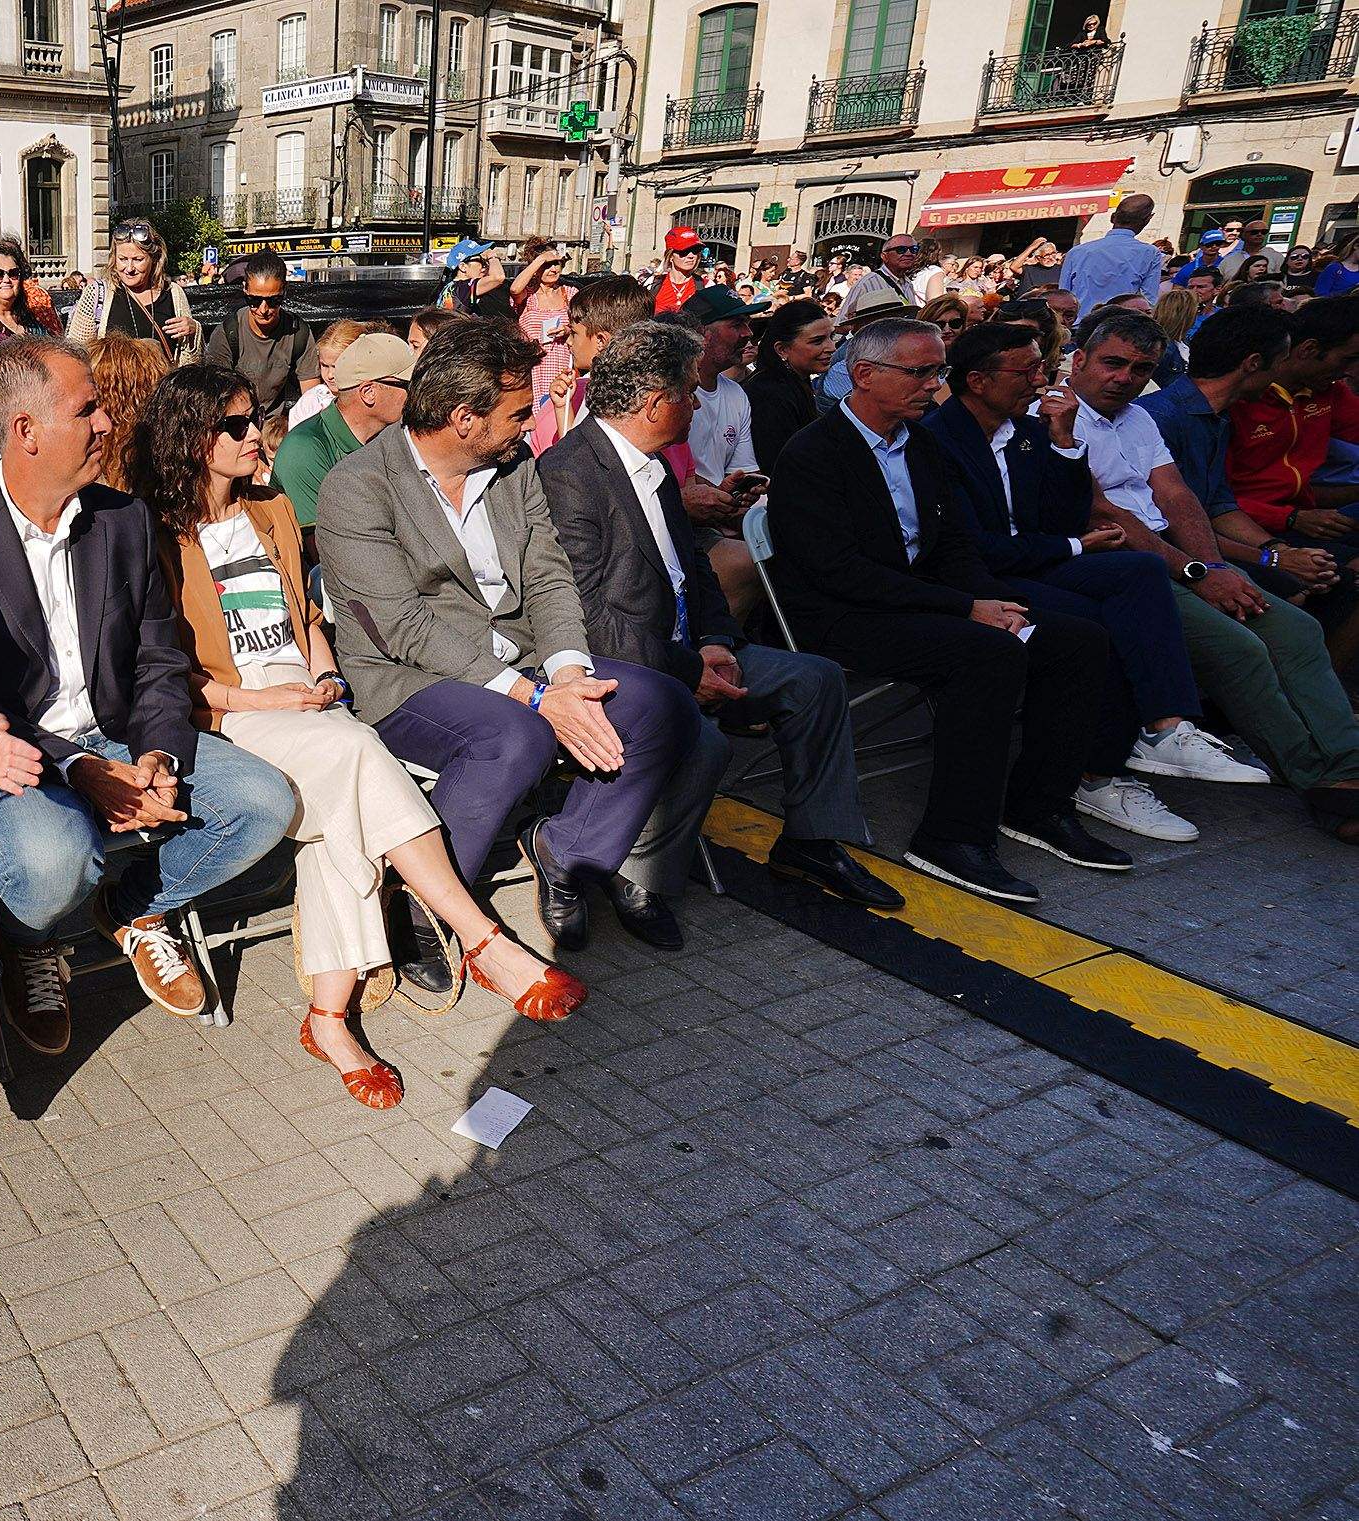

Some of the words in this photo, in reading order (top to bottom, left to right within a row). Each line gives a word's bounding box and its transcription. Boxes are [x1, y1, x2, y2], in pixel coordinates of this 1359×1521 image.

[308, 79, 350, 95] DENTAL
[392, 83, 422, 96] DENTAL
[1255, 175, 1288, 183] ESPAÑA
[947, 203, 1065, 225] EXPENDEDURÍA
